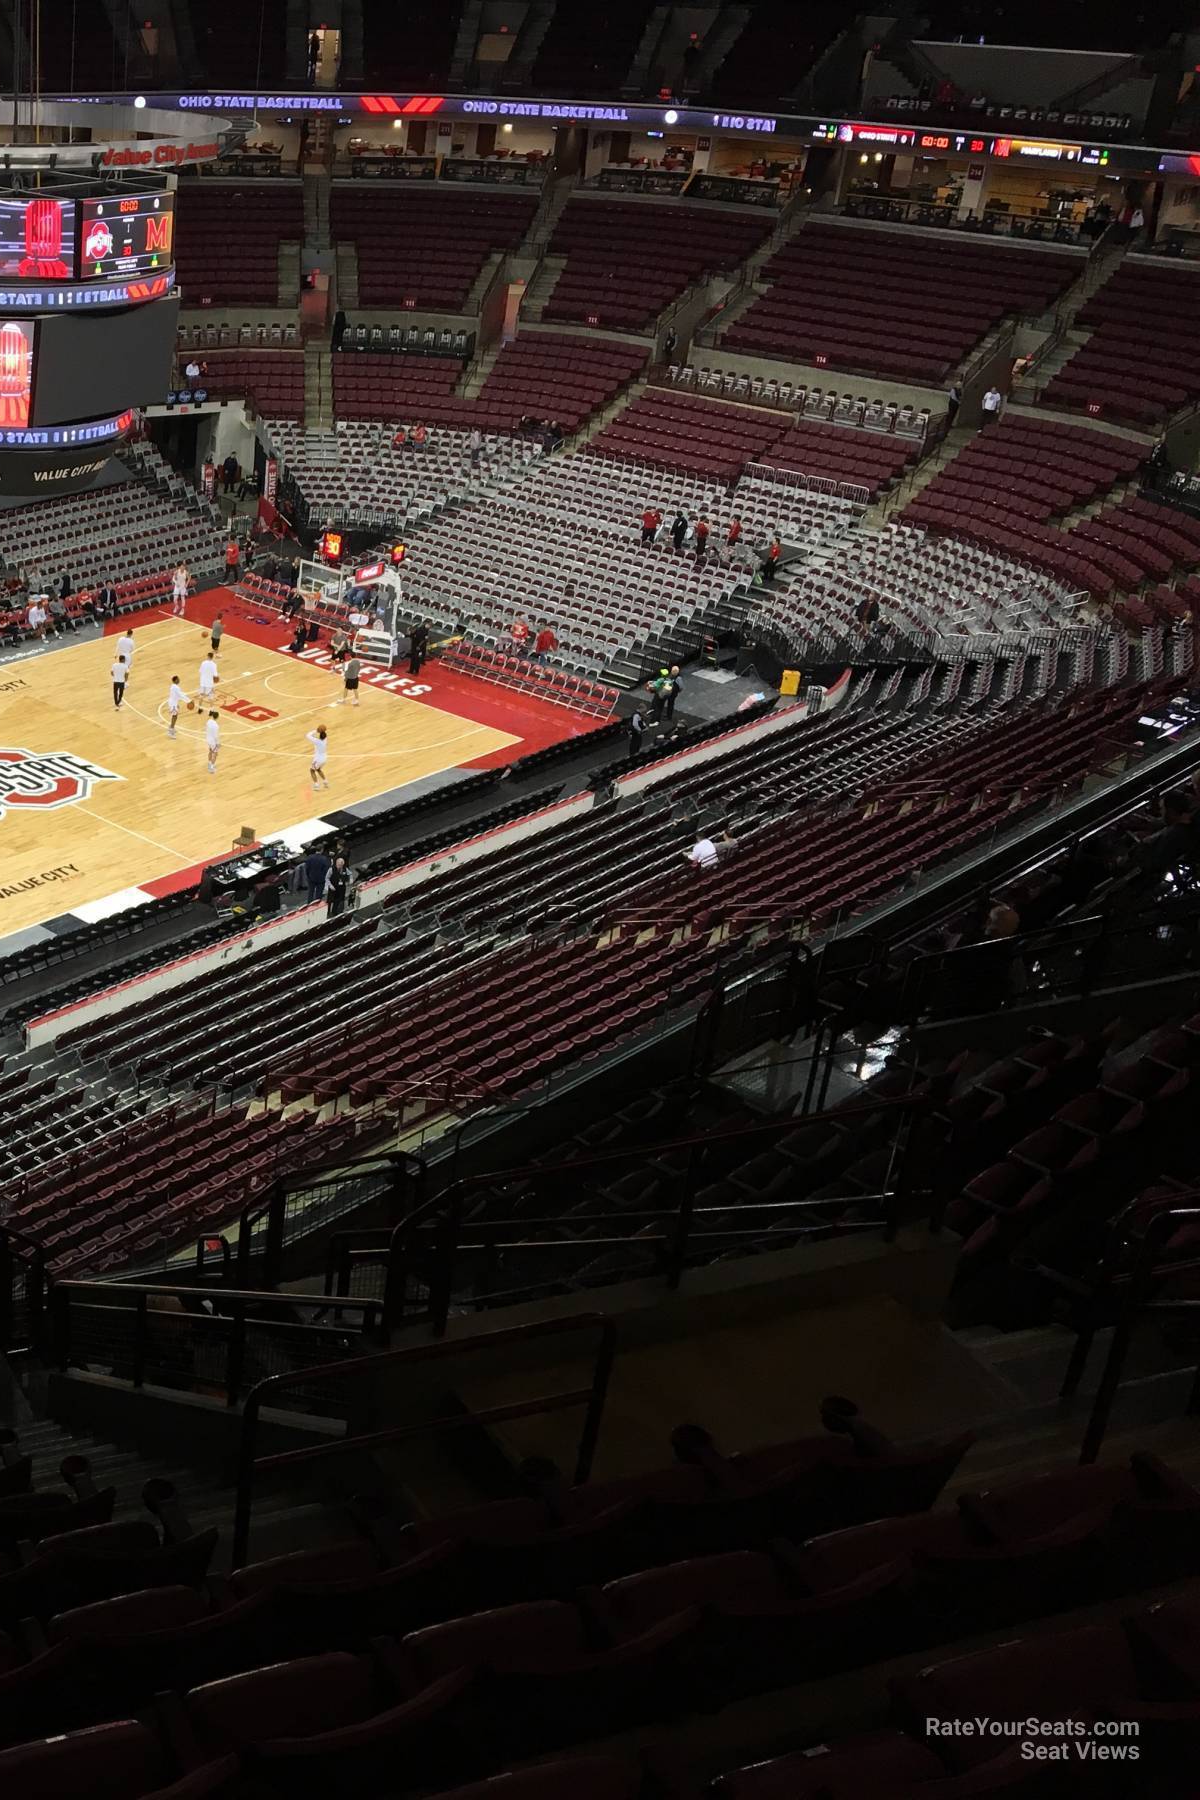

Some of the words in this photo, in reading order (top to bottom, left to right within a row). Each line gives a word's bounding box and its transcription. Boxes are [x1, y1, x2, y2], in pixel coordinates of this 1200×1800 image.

[179, 96, 211, 108] OHIO
[214, 96, 254, 108] STATE
[257, 97, 343, 110] BASKETBALL
[463, 101, 497, 114] OHIO
[500, 103, 540, 116] STATE
[542, 105, 628, 121] BASKETBALL
[921, 136, 949, 148] 60:00
[970, 140, 984, 151] 30
[102, 148, 152, 166] Value
[154, 145, 186, 167] City
[1089, 404, 1100, 413] 117
[34, 469, 69, 482] VALUE
[70, 463, 93, 477] CITY
[40, 863, 79, 882] CITY
